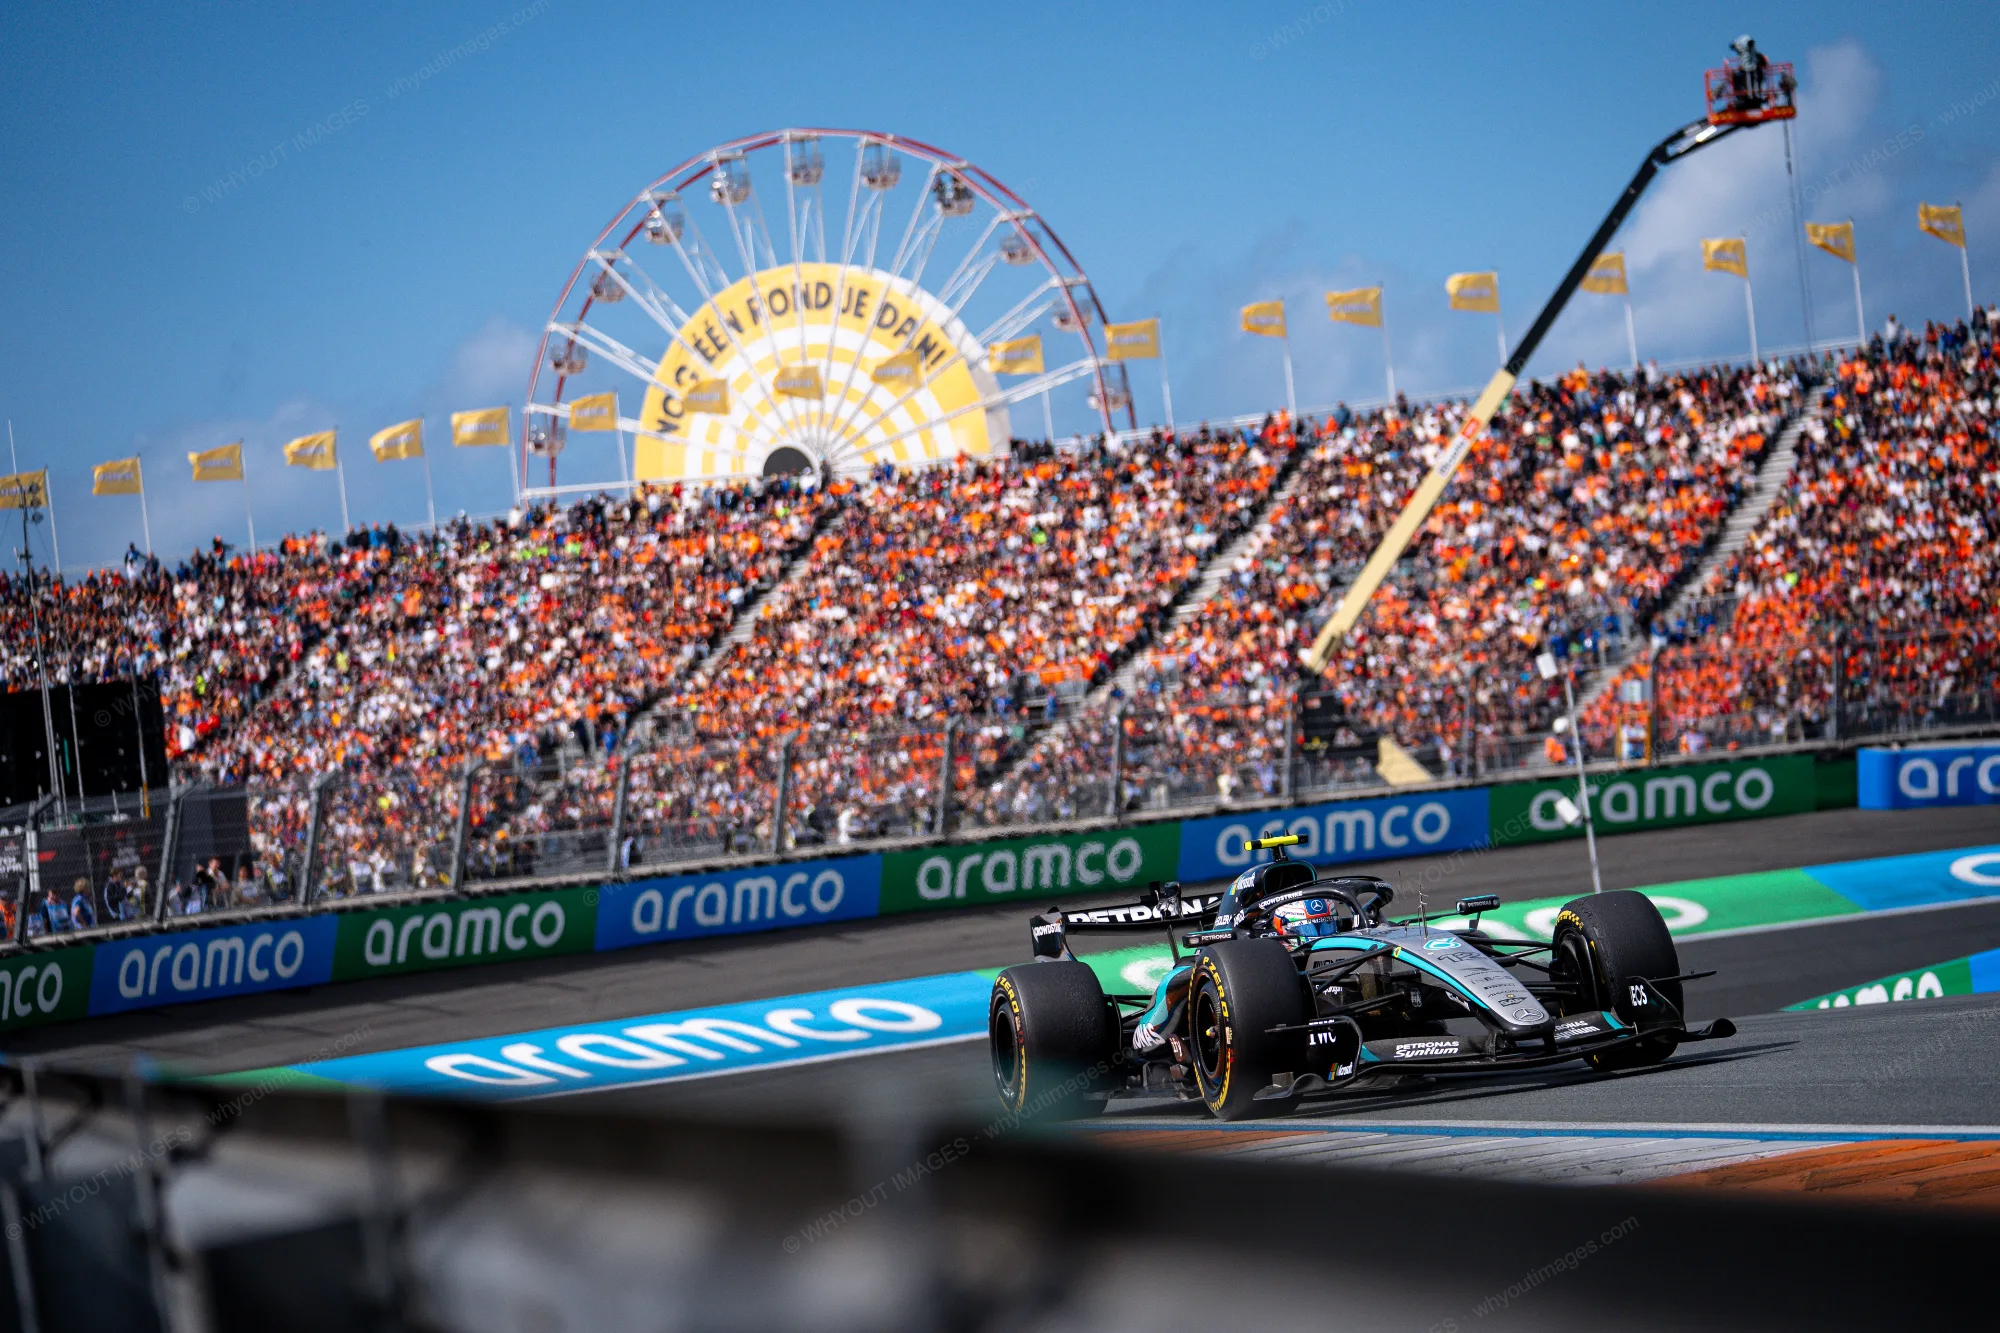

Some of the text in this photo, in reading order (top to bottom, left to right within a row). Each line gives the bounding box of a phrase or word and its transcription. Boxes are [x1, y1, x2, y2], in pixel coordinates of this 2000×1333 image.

[632, 868, 845, 933] aramco
[916, 837, 1143, 900] aramco
[1260, 891, 1303, 909] CROWDSTRIKE
[118, 930, 305, 998] aramco
[365, 901, 566, 966] aramco
[424, 997, 943, 1087] aramco
[1394, 1047, 1459, 1059] Syntium
[1396, 1041, 1460, 1050] PETRONAS
